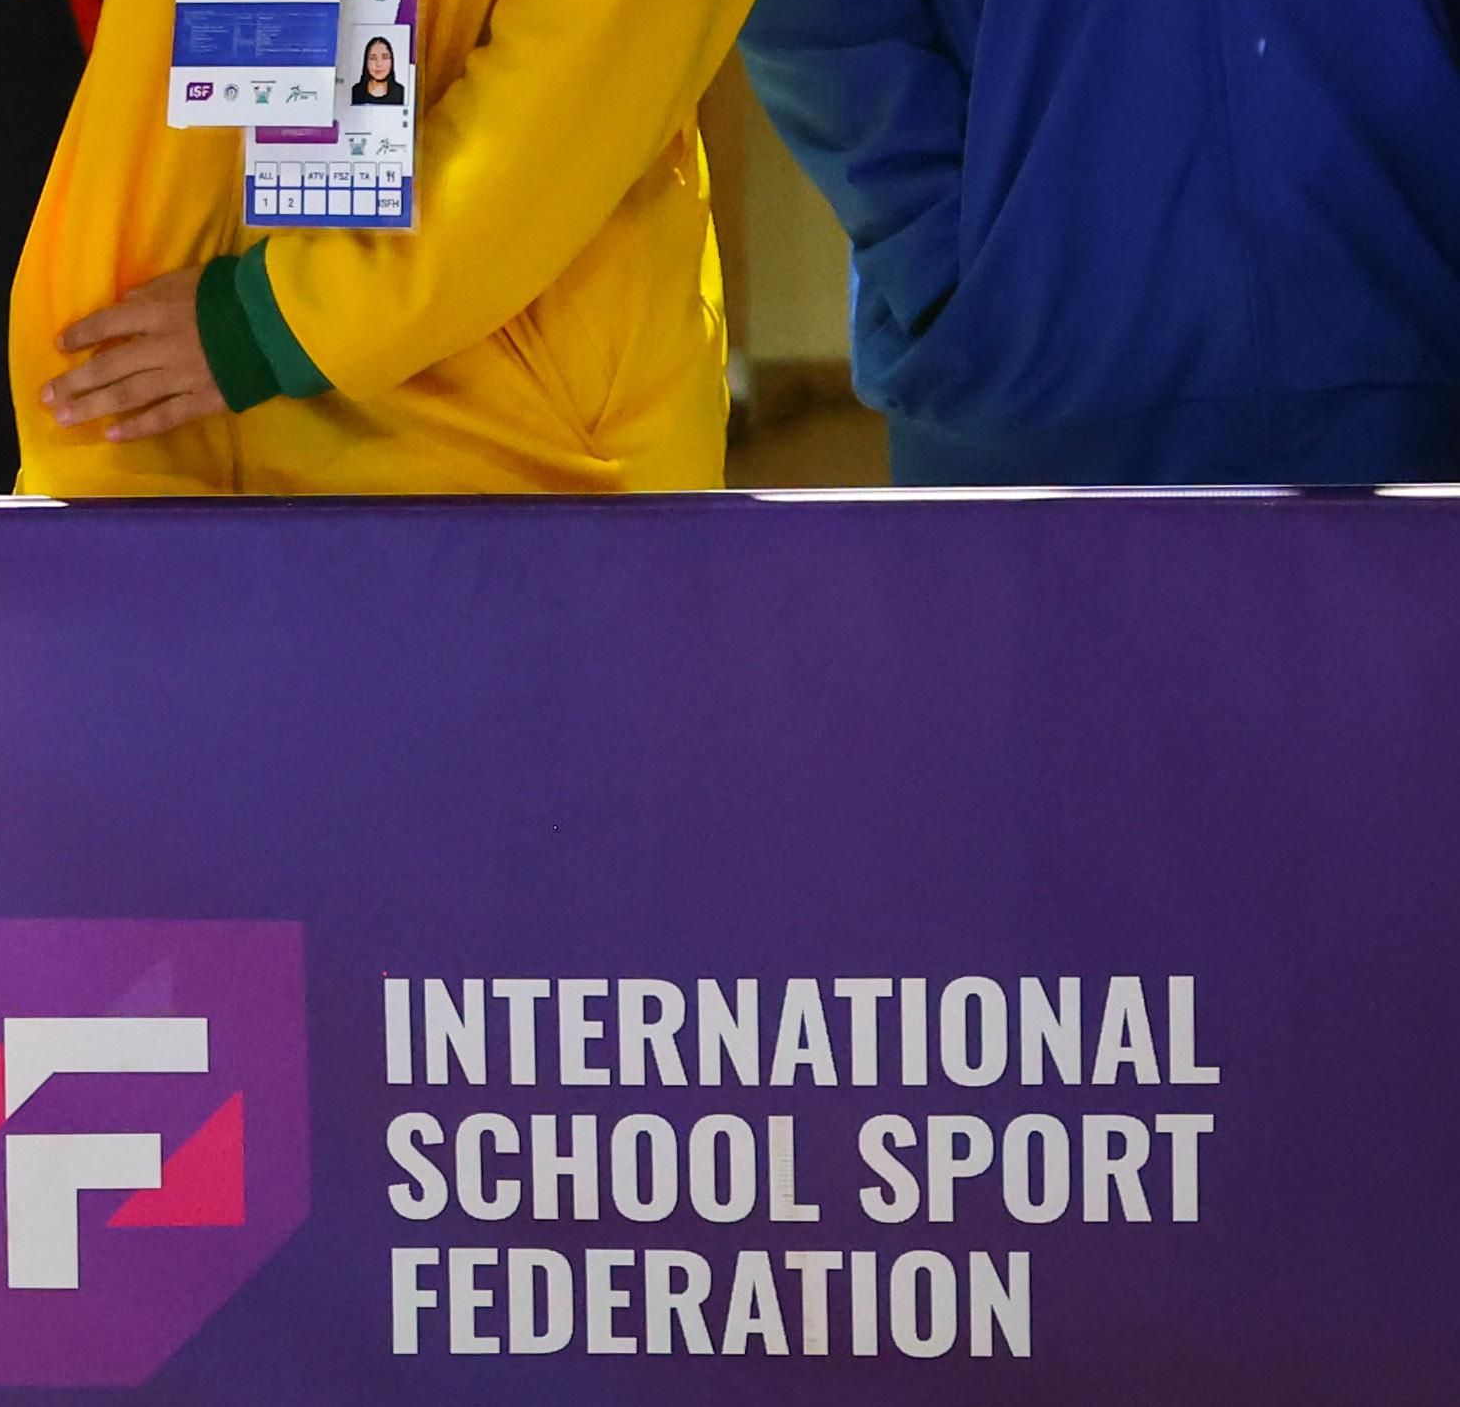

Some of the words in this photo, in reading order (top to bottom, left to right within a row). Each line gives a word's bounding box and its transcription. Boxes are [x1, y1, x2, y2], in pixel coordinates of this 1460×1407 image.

[188, 85, 212, 99] ISF
[287, 197, 295, 208] 2
[384, 975, 1220, 1087] INTERNATIONAL
[386, 1112, 820, 1223] SCHOOL
[858, 1113, 1214, 1224] SPORT
[391, 1247, 1031, 1358] FEDERATION
